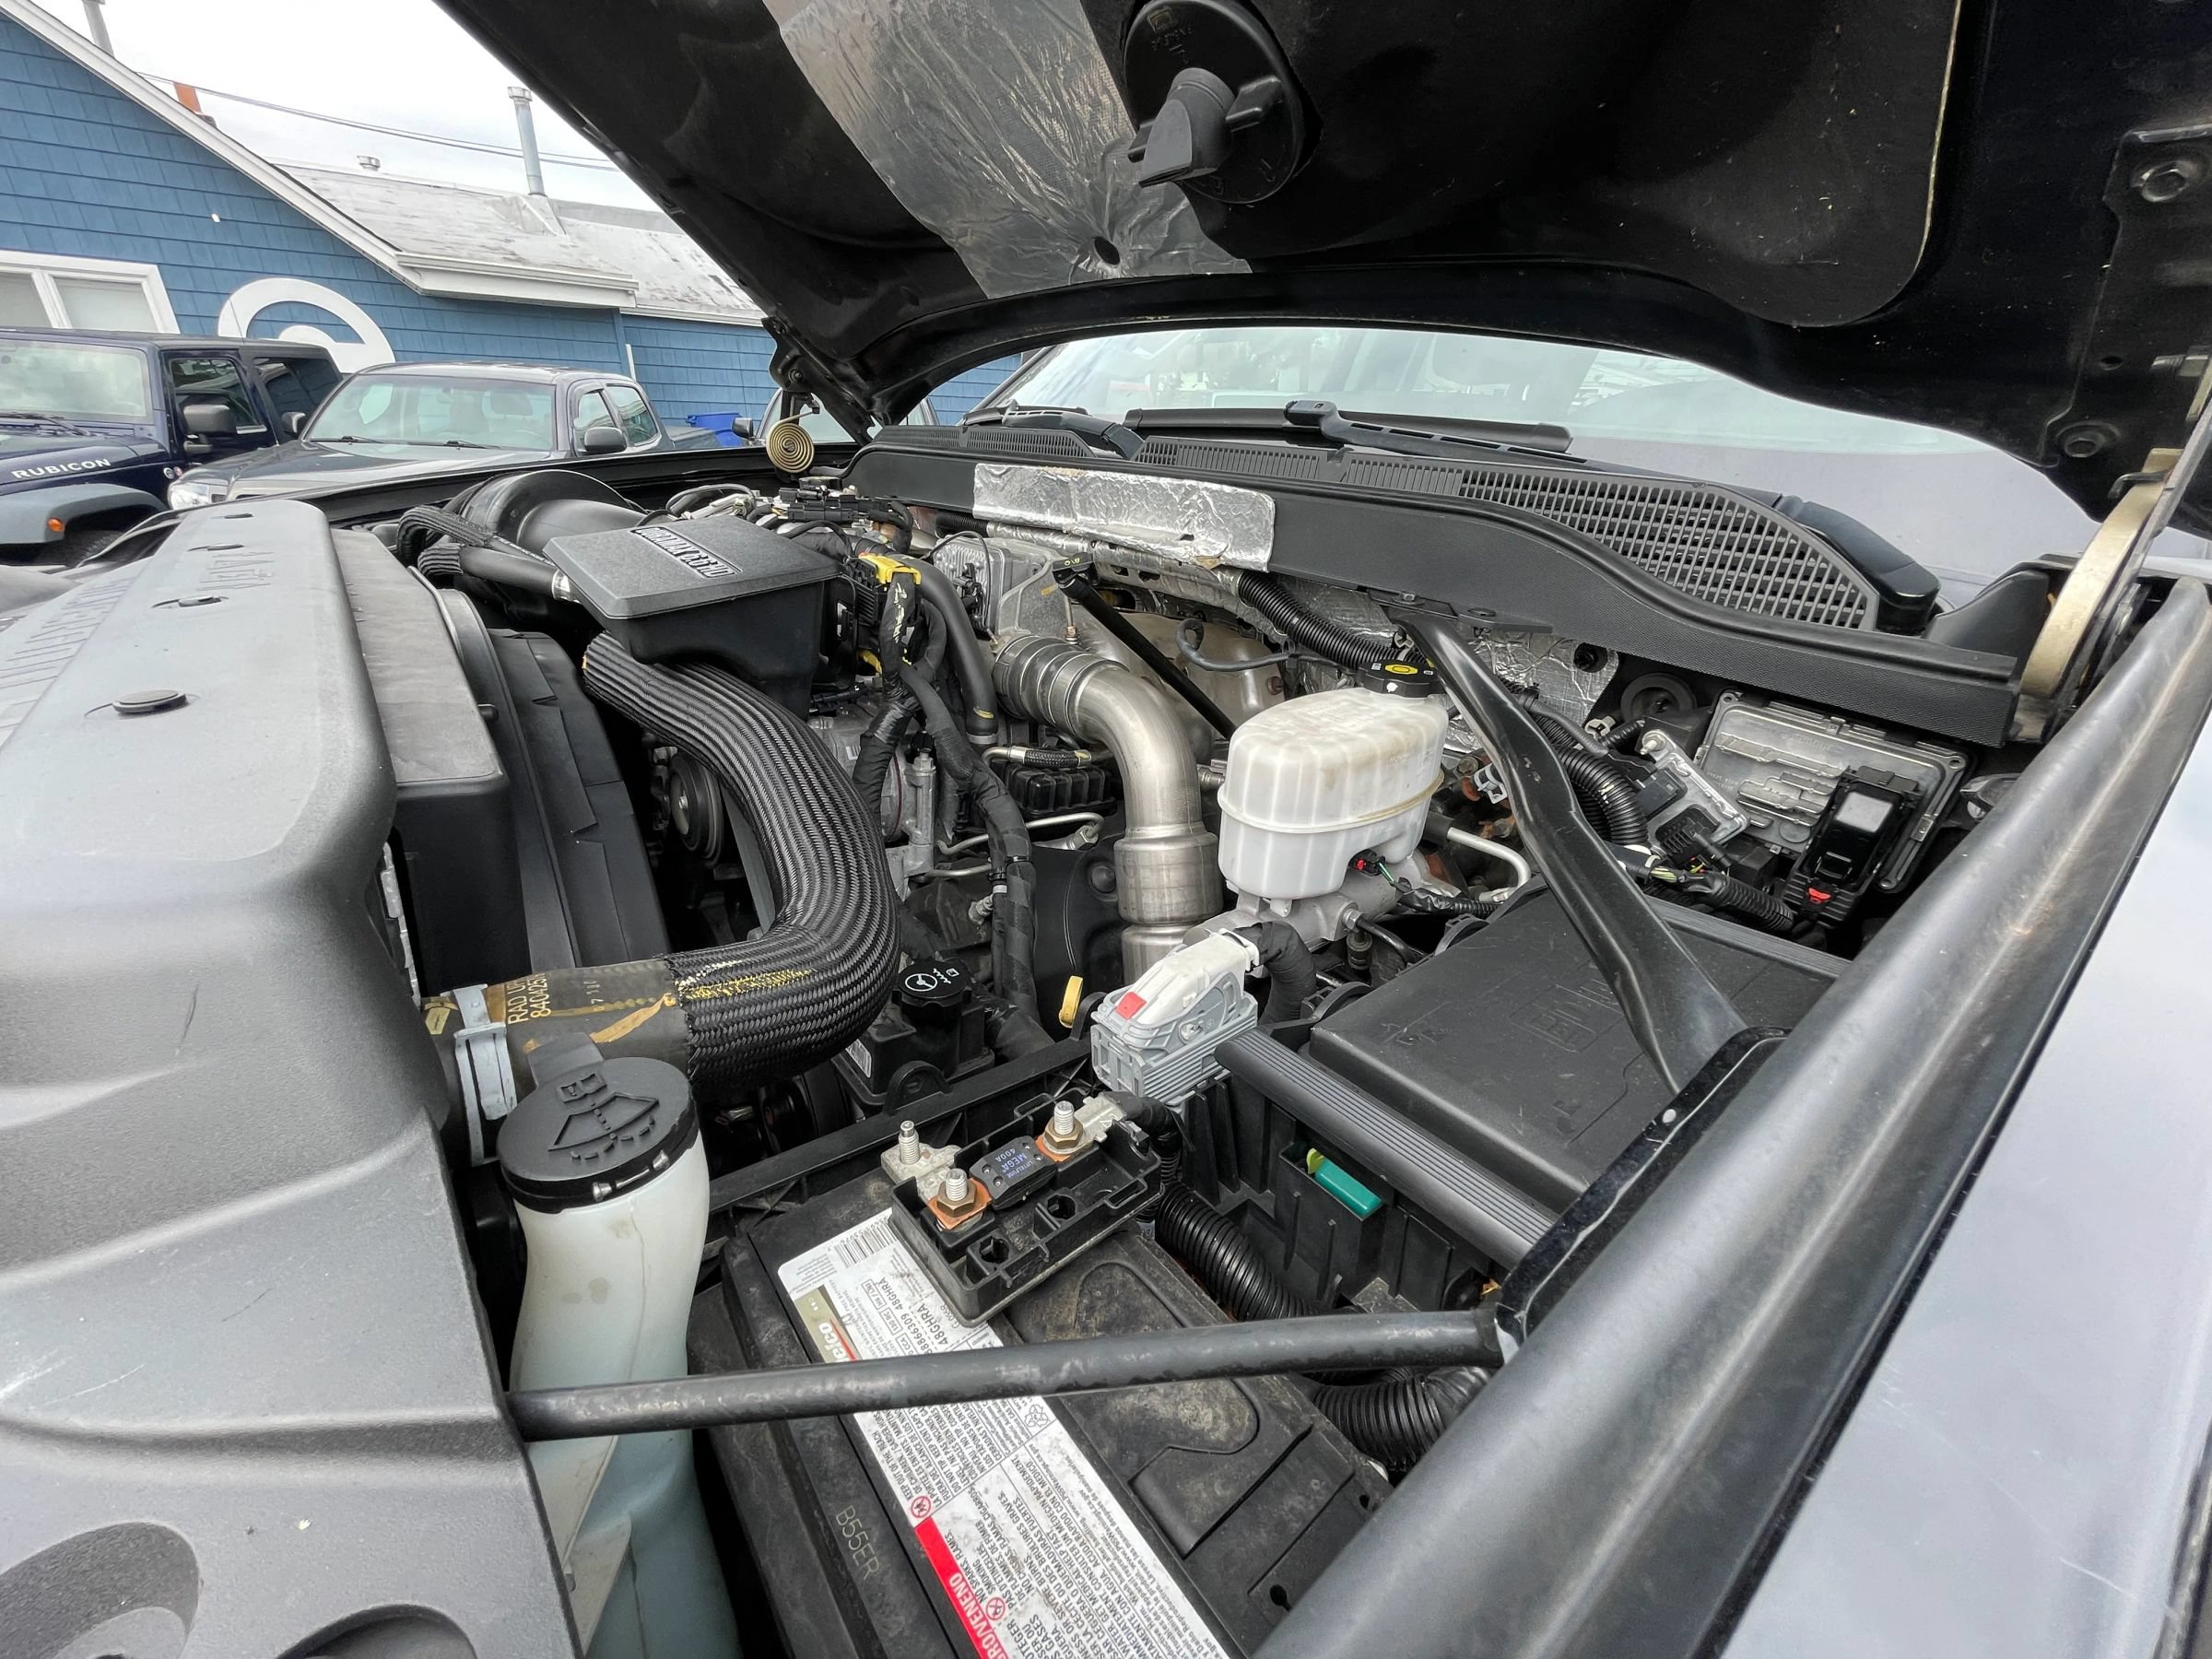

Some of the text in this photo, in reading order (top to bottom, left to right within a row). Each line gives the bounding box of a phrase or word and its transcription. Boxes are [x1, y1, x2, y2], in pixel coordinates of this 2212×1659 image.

[11, 458, 112, 479] RUBICON
[507, 994, 529, 1025] RAD
[995, 1147, 1016, 1162] 400A
[877, 1276, 904, 1312] 48GHRA
[883, 1311, 892, 1320] RC
[915, 1302, 949, 1347] 48GHRA
[814, 1319, 849, 1367] elco
[911, 1411, 924, 1430] CAPS
[960, 1419, 971, 1430] DE
[881, 1426, 898, 1451] GARDER
[919, 1427, 933, 1443] VENT
[943, 1428, 956, 1444] BIEN
[959, 1435, 970, 1447] NO
[928, 1441, 941, 1458] KEEP
[939, 1441, 951, 1455] PAS
[979, 1429, 1002, 1461] CERRADAS
[872, 1430, 913, 1501] KEEP OUT OF THE REACH
[902, 1422, 950, 1500] FUERA DEL ALCANCE DE LOS
[946, 1453, 956, 1464] NE
[951, 1441, 978, 1480] COUVERCLES
[982, 1453, 994, 1467] LOS
[943, 1468, 956, 1483] NOT
[912, 1482, 922, 1494] OF
[950, 1480, 961, 1493] DO
[1042, 1486, 1053, 1498] EL
[932, 1496, 942, 1507] LA
[1048, 1495, 1064, 1513] CON
[1088, 1491, 1099, 1502] de
[974, 1519, 993, 1545] FUMER
[1059, 1511, 1082, 1541] RAPIDO
[836, 1505, 879, 1581] B55ER
[1060, 1531, 1073, 1547] UN
[1112, 1524, 1133, 1549] manos
[987, 1541, 998, 1554] DE
[1077, 1538, 1100, 1569] ACUDA
[1096, 1545, 1112, 1564] after
[1128, 1546, 1140, 1559] las
[1032, 1529, 1074, 1590] QUEMADURAS
[1058, 1547, 1076, 1569] HELP
[1068, 1543, 1102, 1591] CONSULTER
[971, 1558, 995, 1594] SMOKING
[1041, 1563, 1057, 1583] DES
[1107, 1560, 1125, 1584] hands
[973, 1585, 987, 1603] NO
[1014, 1586, 1026, 1601] DE
[1021, 1577, 1034, 1594] NO
[1053, 1581, 1065, 1597] OU
[1069, 1587, 1079, 1598] O
[1070, 1566, 1099, 1606] MEDICAL
[1121, 1582, 1139, 1606] Wash
[1002, 1588, 1017, 1609] PAS
[1041, 1583, 1066, 1620] SEVERE
[1114, 1593, 1131, 1615] CON
[1151, 1594, 1161, 1606] le
[1074, 1594, 1106, 1640] CEGUERA
[1095, 1604, 1110, 1623] GET
[1150, 1608, 1161, 1622] de
[1021, 1622, 1035, 1640] OU
[1029, 1612, 1055, 1652] GASES
[1062, 1618, 1075, 1634] OR
[1081, 1627, 1094, 1642] LA
[1157, 1618, 1183, 1654] Troubles
